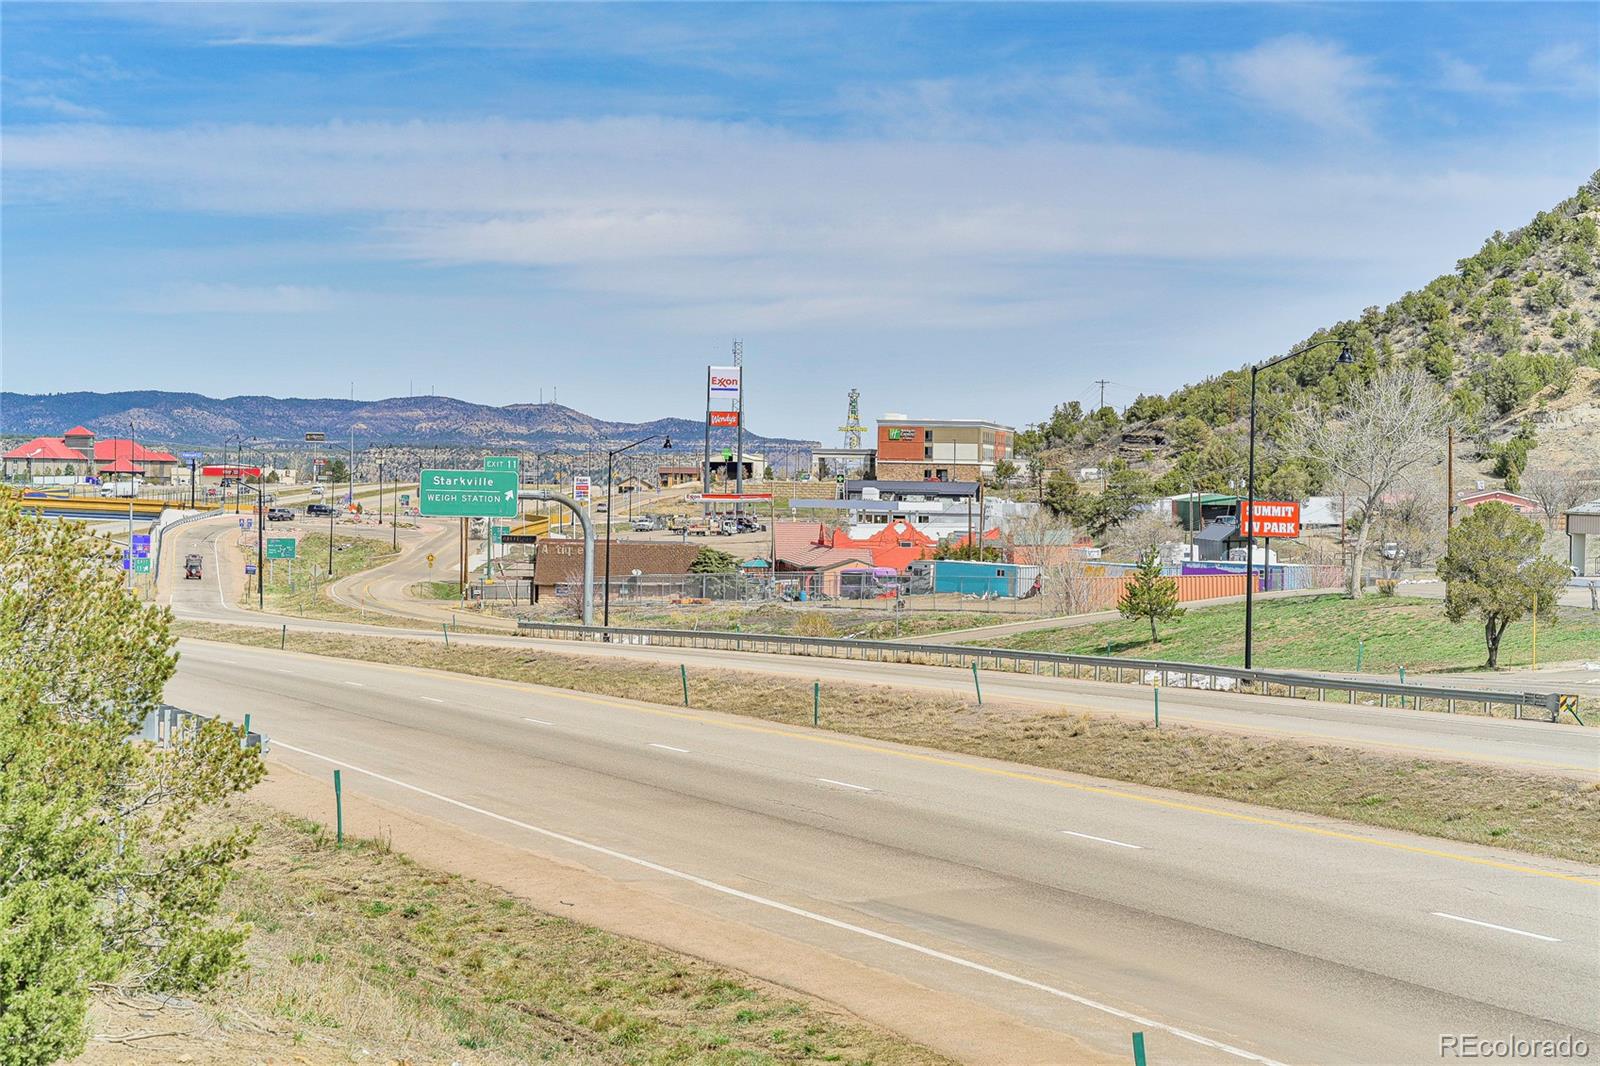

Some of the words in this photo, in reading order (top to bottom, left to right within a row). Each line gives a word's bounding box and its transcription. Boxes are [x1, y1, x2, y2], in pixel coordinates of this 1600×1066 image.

[711, 377, 738, 387] Exxon
[486, 460, 504, 468] EXIT
[507, 460, 517, 469] 11
[433, 475, 494, 487] Starkville
[427, 493, 457, 502] WEIGH
[461, 493, 501, 503] STATION
[1263, 521, 1296, 534] PARK
